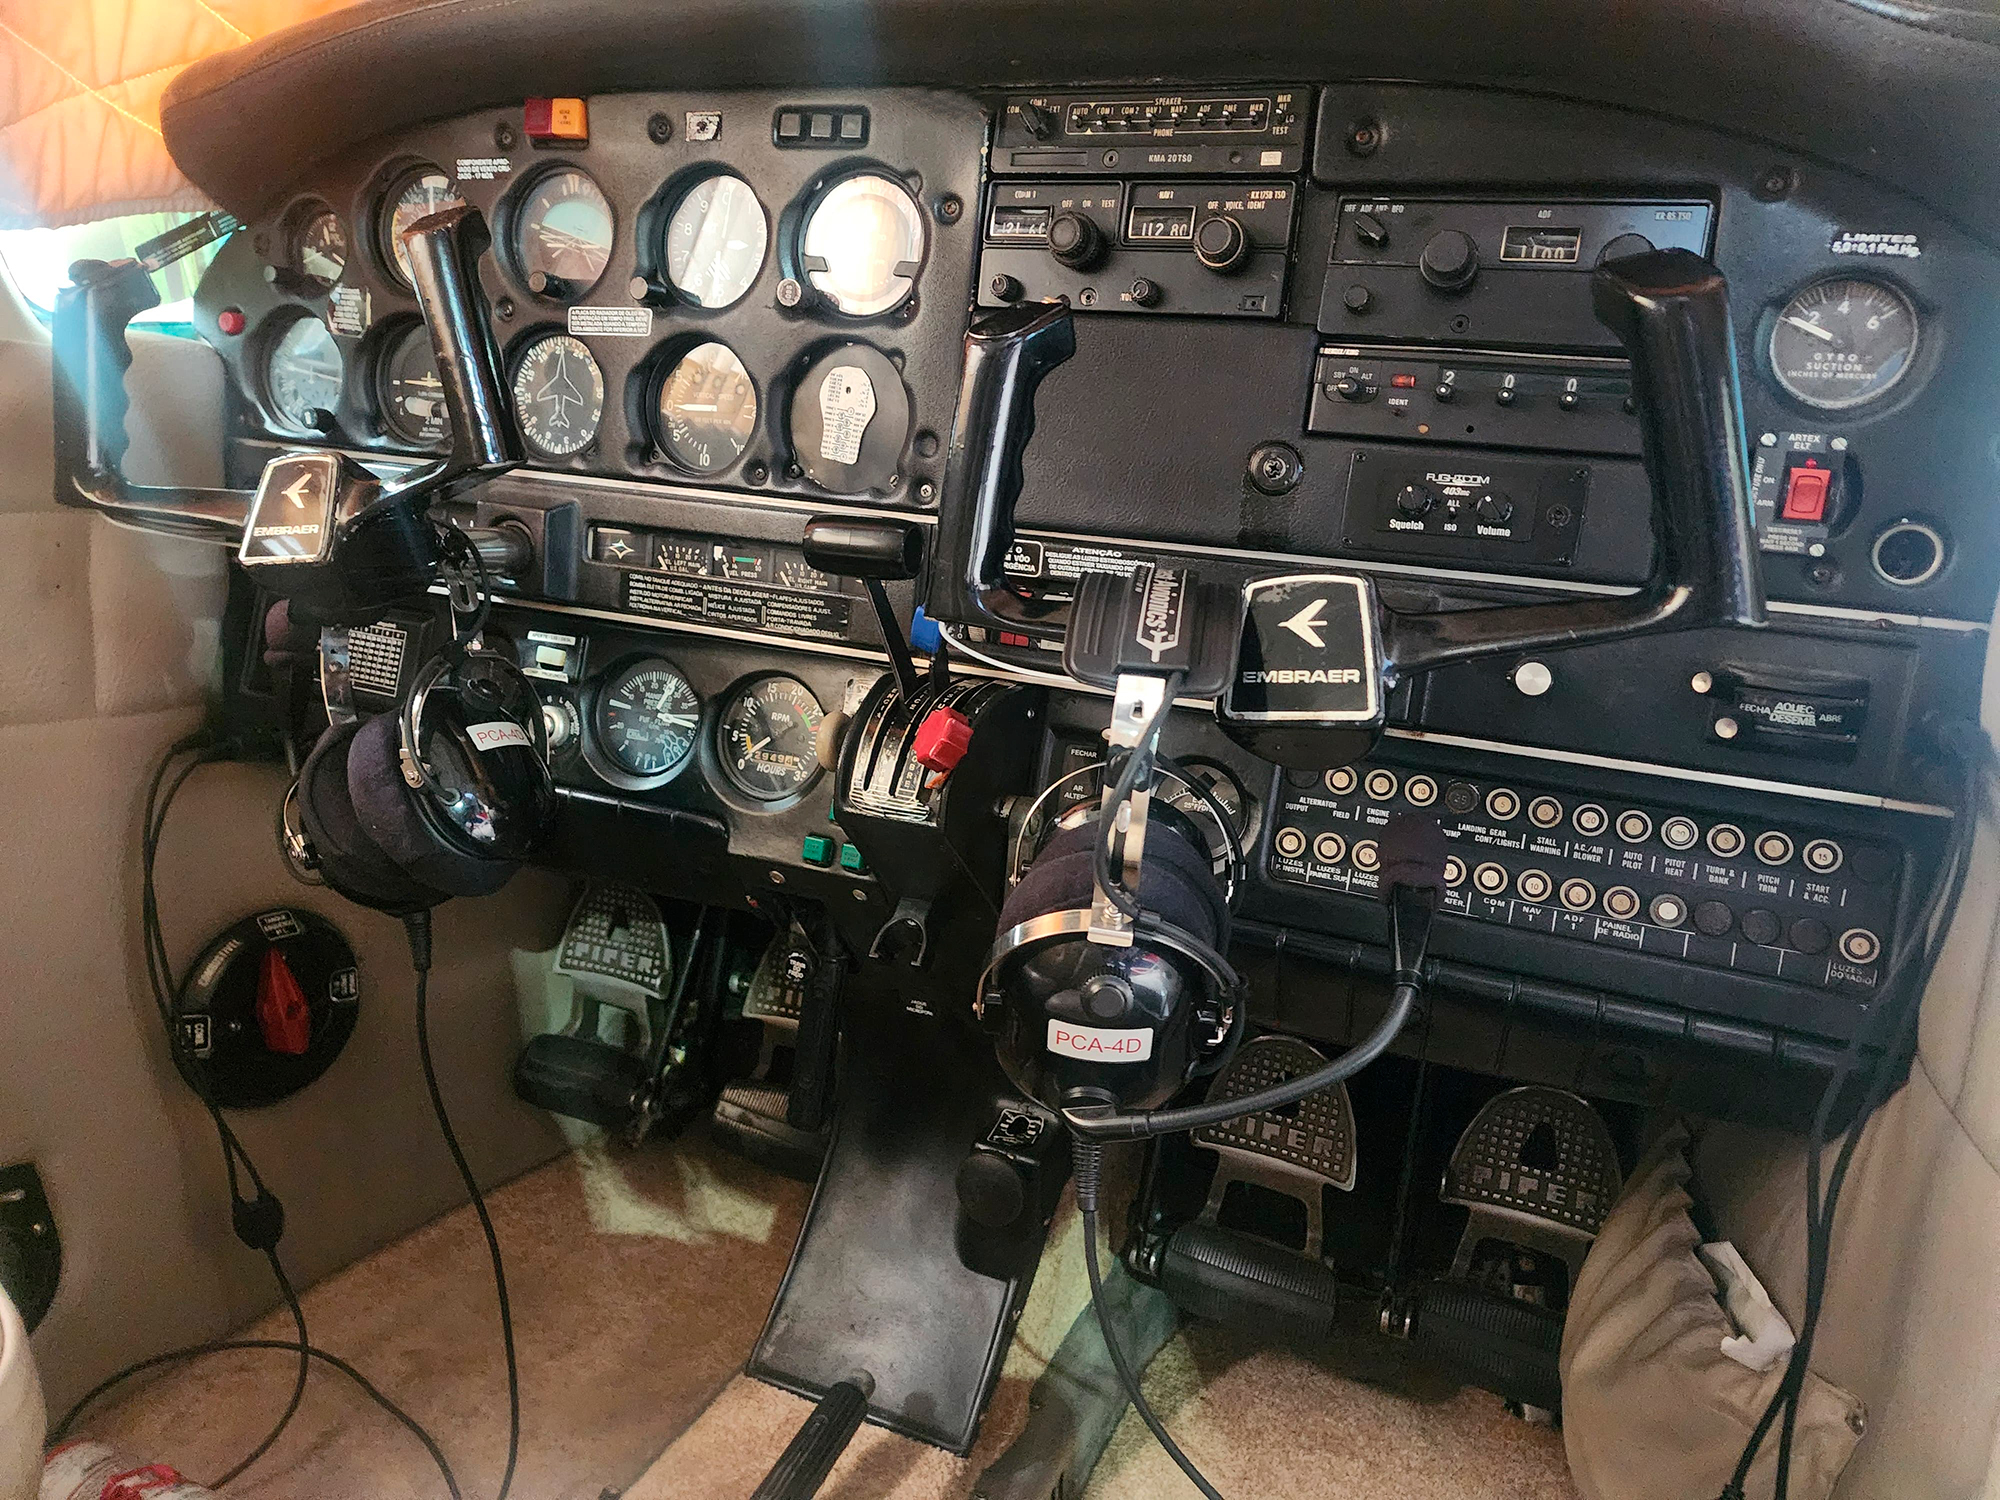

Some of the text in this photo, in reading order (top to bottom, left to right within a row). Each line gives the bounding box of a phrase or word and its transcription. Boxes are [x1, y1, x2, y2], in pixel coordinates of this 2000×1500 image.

[1155, 97, 1181, 105] SPEAKER
[1277, 94, 1291, 102] MKR
[1273, 127, 1288, 135] TEST
[1149, 154, 1165, 162] KMA
[700, 200, 709, 213] 9
[1062, 200, 1073, 208] OFF
[1102, 200, 1115, 208] TEST
[1208, 201, 1218, 209] OFF
[1537, 210, 1552, 219] ADF
[684, 223, 693, 235] 8
[1842, 233, 1917, 243] LIMITES
[681, 250, 690, 262] 7
[1838, 301, 1850, 314] 4
[1808, 311, 1820, 325] 2
[1867, 315, 1880, 330] 6
[573, 350, 584, 360] 24
[1814, 353, 1858, 361] GYRO
[1806, 362, 1863, 371] SUCTION
[1445, 371, 1455, 385] 2
[1788, 370, 1819, 378] INCHES
[1835, 371, 1877, 380] MERCURY
[1504, 374, 1515, 389] 0
[1567, 378, 1577, 392] 0
[667, 400, 673, 410] 0
[581, 429, 588, 437] 0
[673, 429, 680, 442] 5
[1788, 434, 1821, 443] ARTEX
[1794, 442, 1811, 450] ELT
[699, 453, 710, 466] 10
[1389, 519, 1424, 530] Squelch
[254, 524, 319, 537] EMBRAER
[1477, 525, 1511, 536] Volume
[1072, 547, 1122, 558] ATENÇÃO
[1014, 554, 1030, 563] VÔO
[708, 593, 762, 605] MISTURA AJUSTADA
[728, 605, 756, 614] AJUSTADA
[767, 608, 796, 618] COMANDOS
[1243, 669, 1361, 683] EMBRAER
[767, 683, 778, 693] 15
[791, 685, 803, 696] 20
[743, 697, 754, 708] 10
[771, 713, 790, 721] RPM
[1739, 702, 1842, 723] FECHA AQUEC. ABRE
[1769, 713, 1816, 726] DESEMB.
[476, 729, 525, 744] PCA-4D
[732, 730, 739, 741] 5
[1071, 749, 1098, 759] FECHAR
[738, 759, 745, 770] 0
[757, 764, 786, 776] HOURS
[1285, 803, 1308, 812] OUTPUT
[1299, 797, 1338, 809] ALTERNATOR
[1333, 810, 1350, 819] FIELD
[1367, 807, 1390, 818] ENGINE
[1367, 815, 1388, 825] GROUP
[1585, 816, 1596, 824] 20
[1458, 823, 1507, 837] LANDING GEAR
[1475, 835, 1520, 849] CONT/LIGHTS
[1537, 836, 1556, 846] STALL
[1530, 844, 1561, 856] WARNING
[1573, 852, 1601, 863] BLOWER
[1623, 852, 1643, 861] AUTO
[1819, 853, 1828, 861] 15
[1278, 857, 1303, 867] LUZES
[1622, 860, 1642, 870] PILOT
[1665, 858, 1686, 868] PITOT
[1283, 865, 1306, 875] INSTR.
[1316, 865, 1341, 874] LUZES
[1665, 867, 1684, 877] HEAT
[1706, 865, 1735, 877] TURN &
[1309, 870, 1332, 880] PAINEL
[1354, 871, 1380, 881] LUZES
[1708, 875, 1729, 885] BANK
[1757, 874, 1780, 885] PITCH
[1352, 878, 1379, 888] NAVEG.
[1806, 883, 1830, 893] START
[1759, 884, 1777, 893] TRIM
[1484, 898, 1506, 907] COM
[1804, 892, 1830, 904] & ACC.
[1523, 906, 1542, 915] NAV
[1564, 914, 1585, 923] ADF
[1602, 921, 1632, 932] PAINEL
[1598, 927, 1640, 941] DE RADIO
[575, 942, 652, 973] PIPER
[1833, 963, 1863, 975] LUZES
[1831, 971, 1843, 980] DO
[1056, 1030, 1142, 1054] PCA-4D
